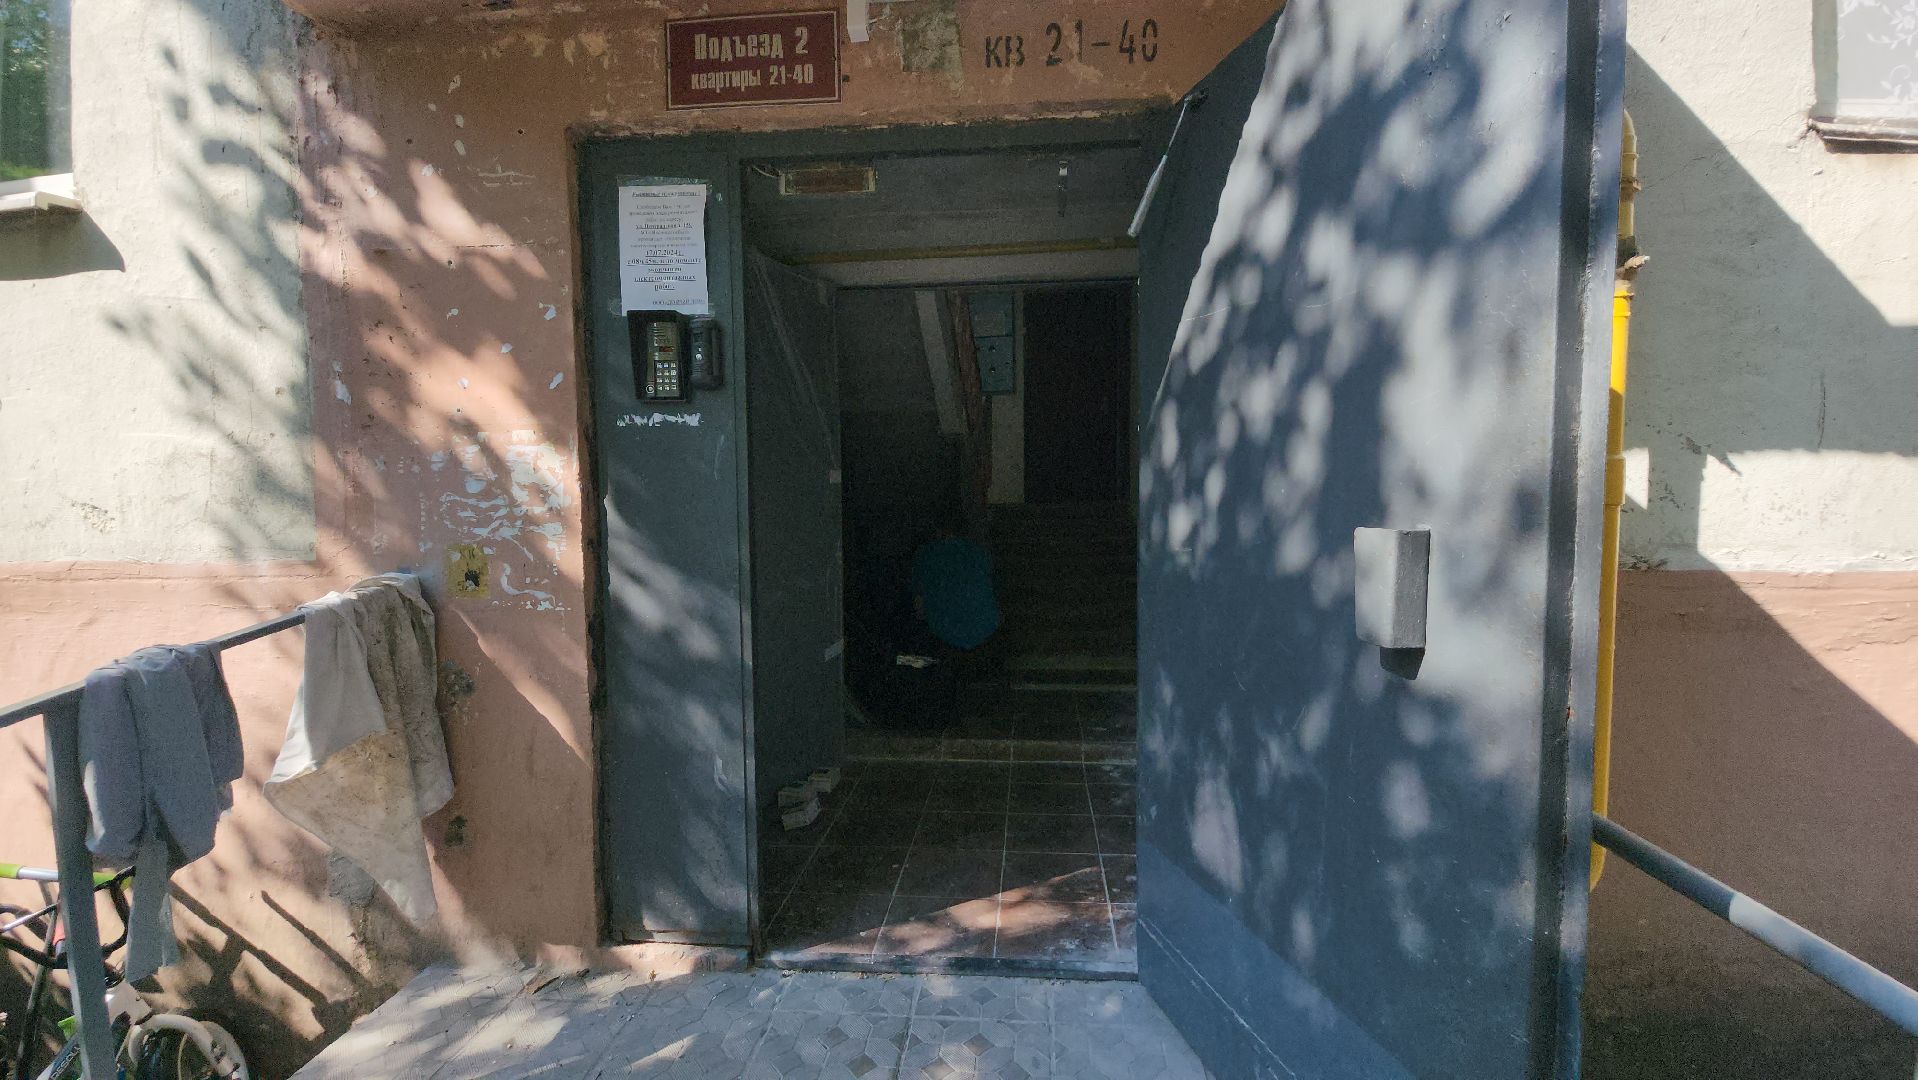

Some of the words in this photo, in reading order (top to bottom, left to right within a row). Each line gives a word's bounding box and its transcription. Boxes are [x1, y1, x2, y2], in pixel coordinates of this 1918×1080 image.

[694, 33, 784, 62] Подъезд
[794, 26, 808, 54] 2
[1045, 18, 1158, 67] 21-40
[691, 69, 761, 93] квартиры
[769, 63, 814, 85] 21-40
